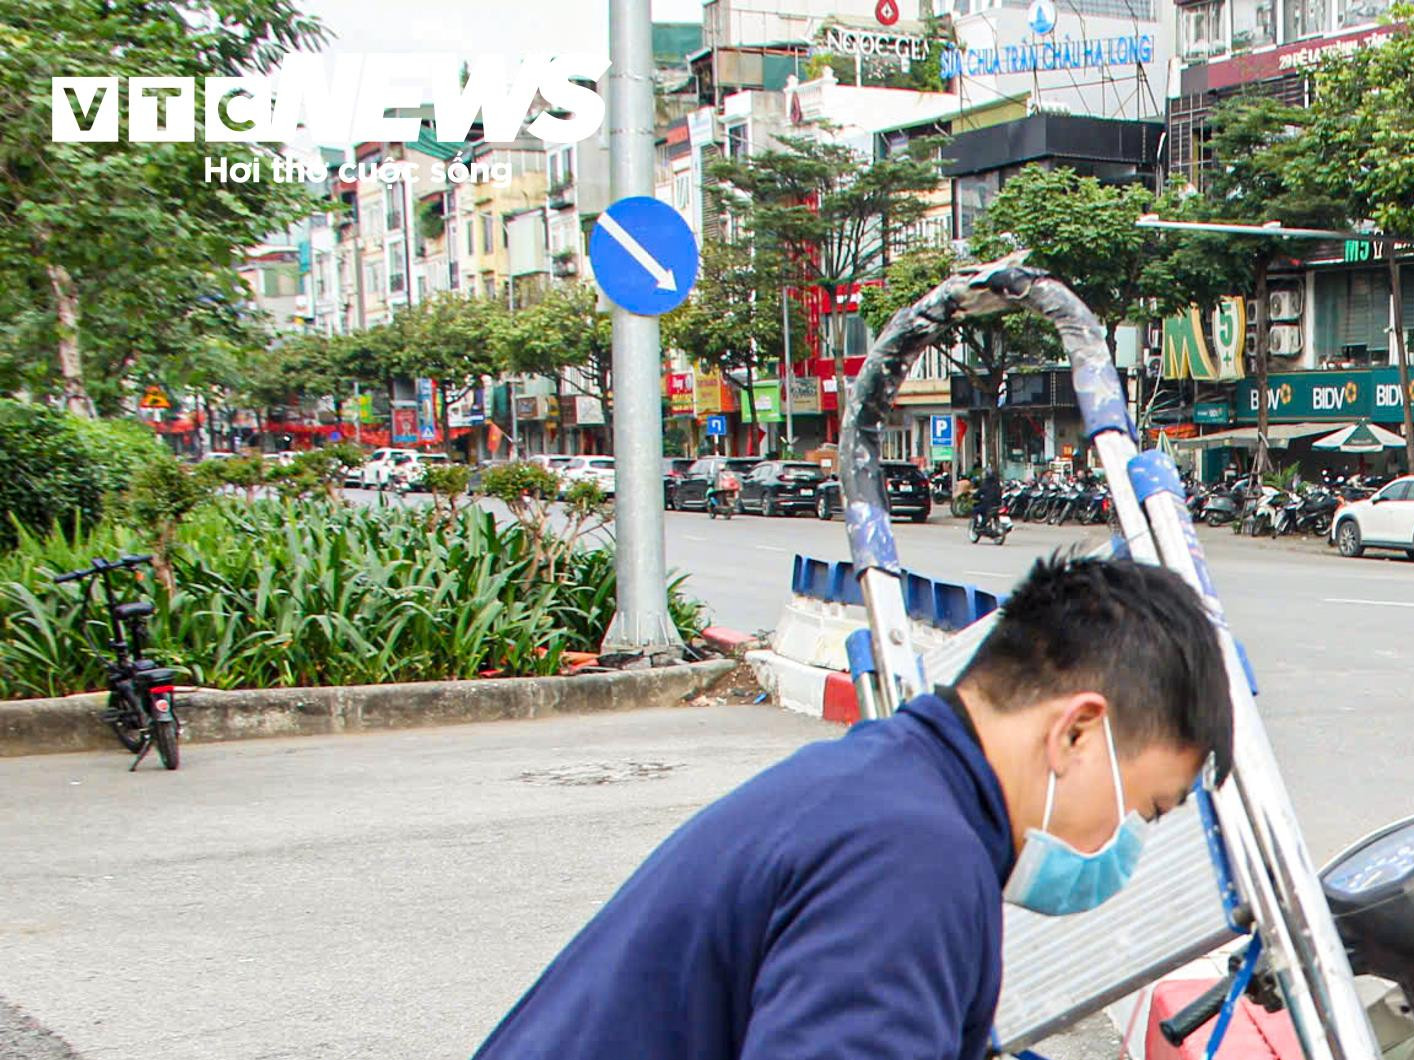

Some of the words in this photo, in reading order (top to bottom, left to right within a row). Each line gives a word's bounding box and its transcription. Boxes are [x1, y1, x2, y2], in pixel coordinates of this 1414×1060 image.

[968, 48, 1001, 75] CHUA
[1108, 35, 1152, 65] LONG
[1313, 387, 1345, 410] BIDV
[936, 420, 948, 437] P
